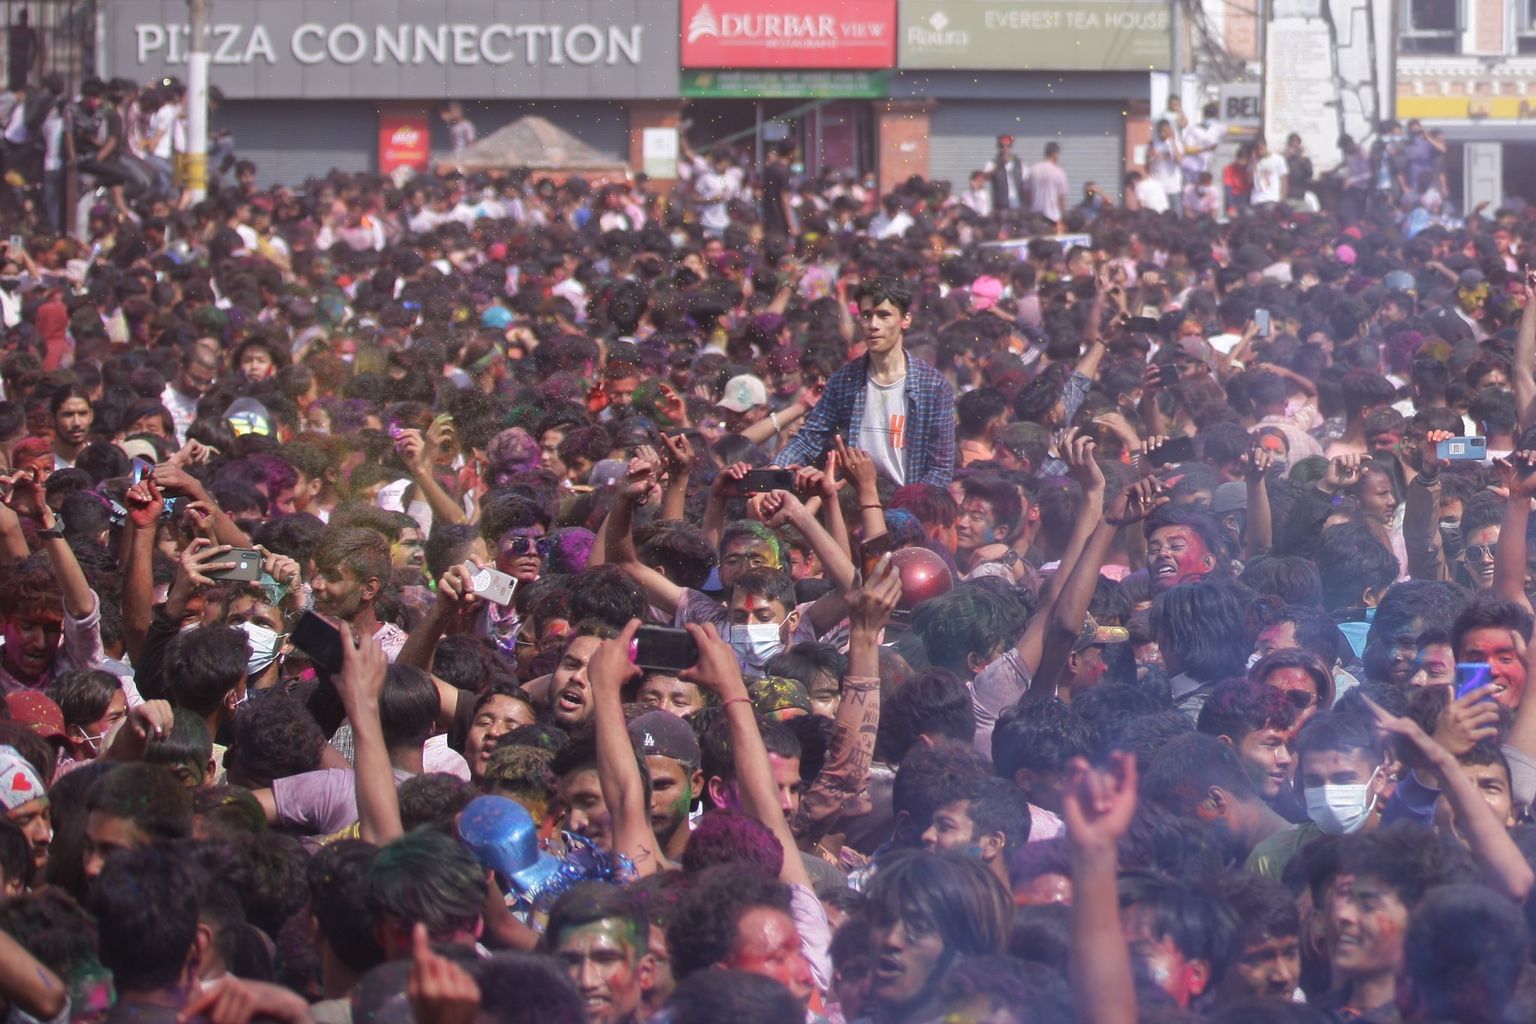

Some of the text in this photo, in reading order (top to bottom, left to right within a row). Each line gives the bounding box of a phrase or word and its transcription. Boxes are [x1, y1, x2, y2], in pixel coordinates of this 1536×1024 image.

[721, 12, 886, 39] DURBAR VIEW
[984, 10, 1060, 29] EVEREST
[1066, 11, 1099, 29] TEA
[1103, 11, 1170, 31] HOUSE
[135, 23, 643, 65] PIZA CONNECTION
[643, 732, 655, 747] LA
